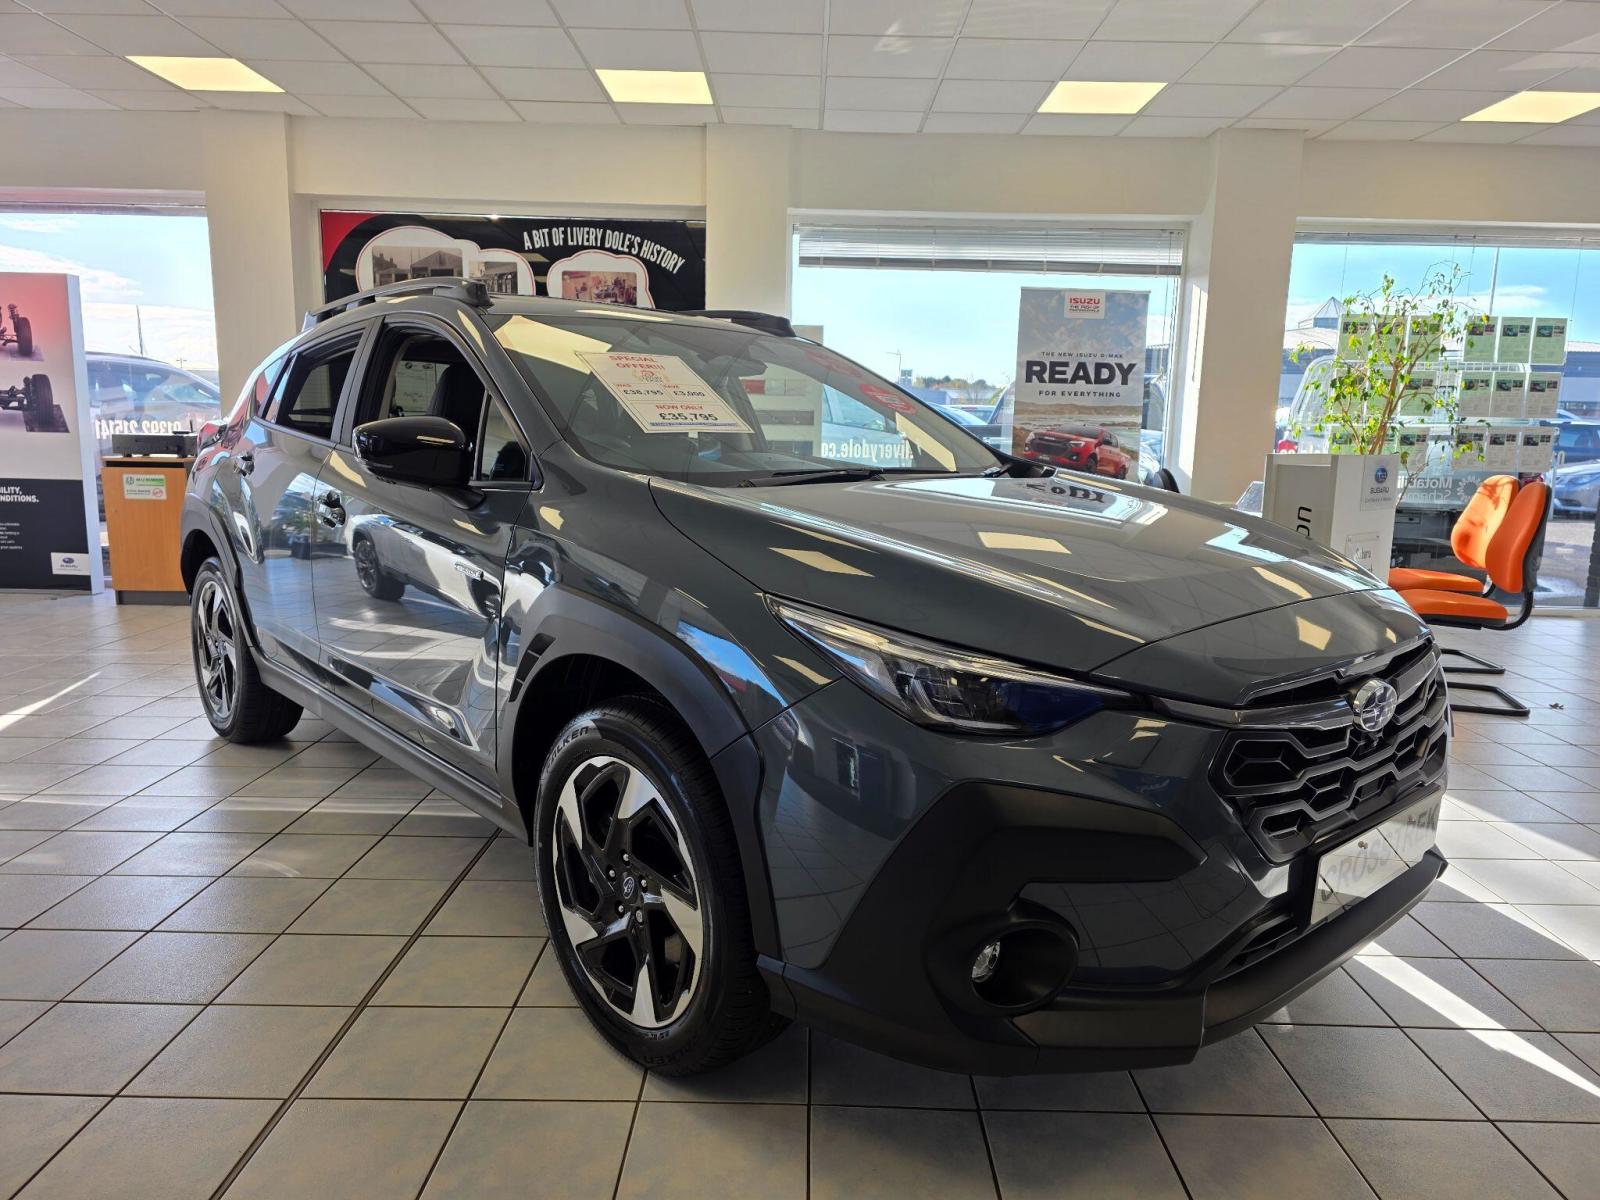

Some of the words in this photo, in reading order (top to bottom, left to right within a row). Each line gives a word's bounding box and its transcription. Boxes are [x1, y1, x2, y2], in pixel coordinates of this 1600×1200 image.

[523, 231, 533, 250] A
[532, 228, 550, 249] BIT
[552, 227, 565, 247] OF
[567, 226, 603, 247] LIVERY
[605, 230, 641, 255] DOLE'S
[640, 239, 686, 274] HISTORY
[1069, 297, 1100, 305] ISUZU
[1025, 360, 1138, 385] READY
[659, 412, 718, 421] £35,795
[0, 486, 22, 495] ILITY,
[0, 495, 39, 503] NDITIONS.
